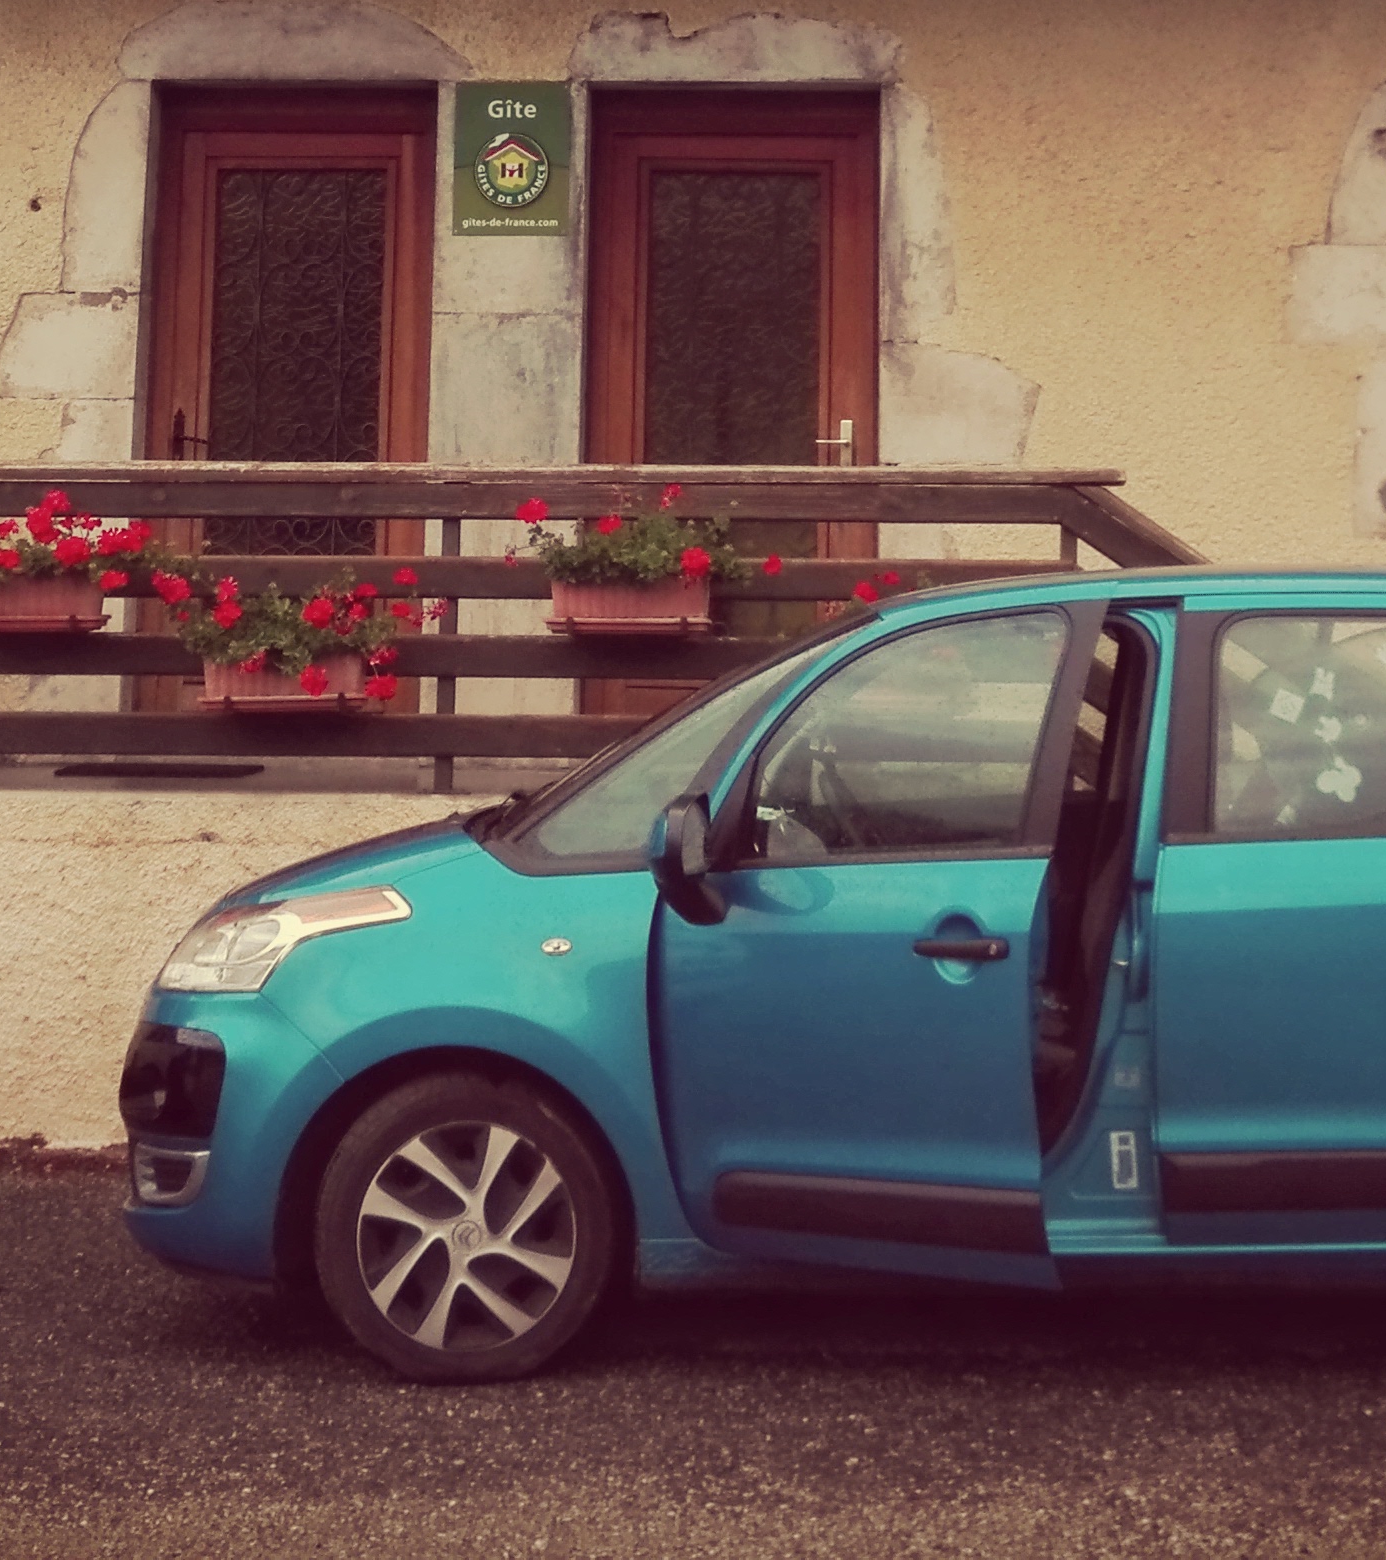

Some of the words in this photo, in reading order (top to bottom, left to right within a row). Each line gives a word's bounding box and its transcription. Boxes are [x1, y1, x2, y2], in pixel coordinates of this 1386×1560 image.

[487, 99, 537, 119] Gîte
[497, 194, 513, 204] DE
[517, 164, 546, 203] FRANCE
